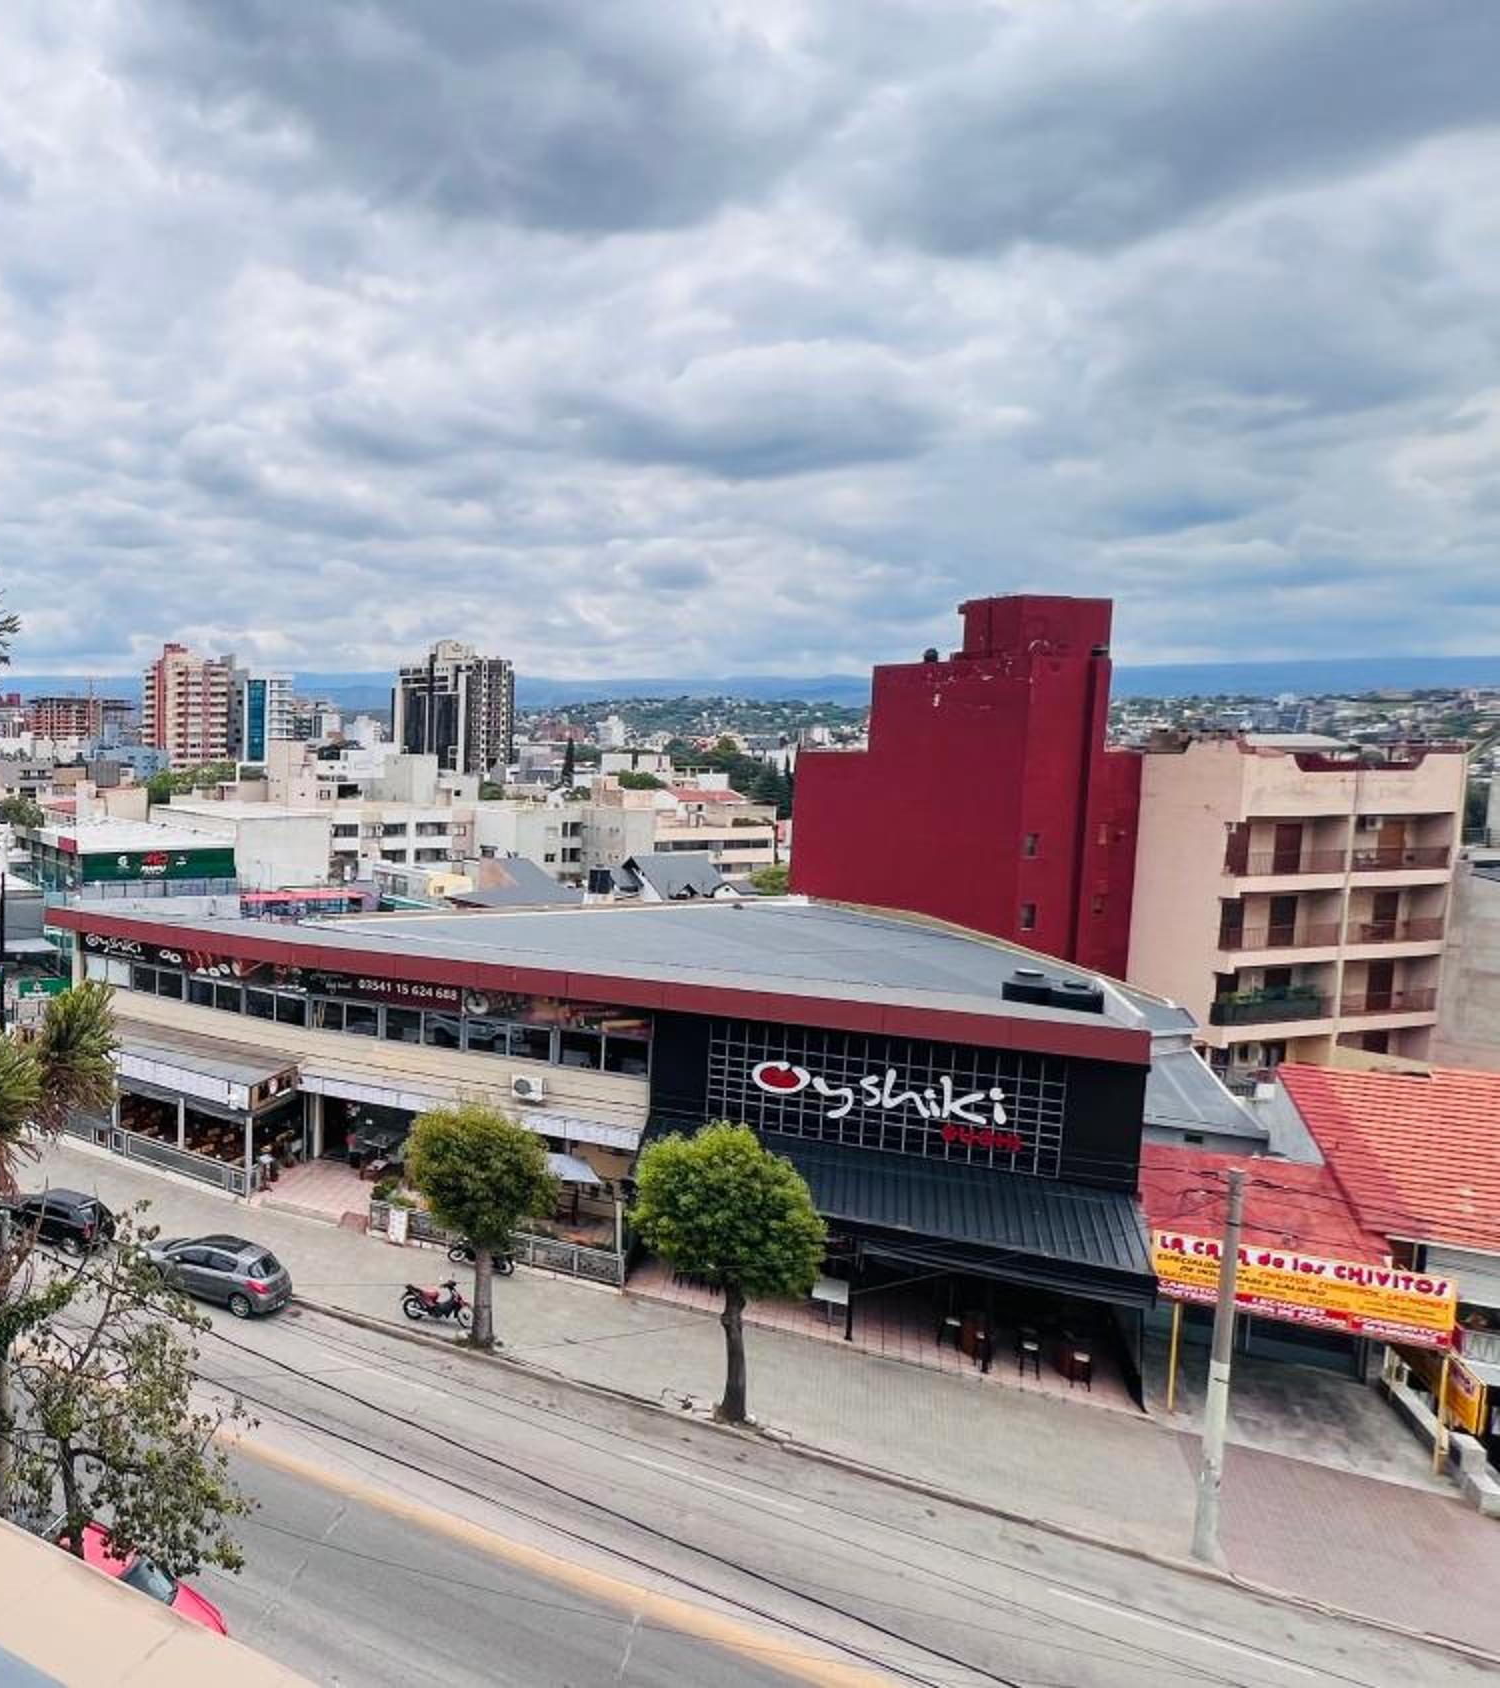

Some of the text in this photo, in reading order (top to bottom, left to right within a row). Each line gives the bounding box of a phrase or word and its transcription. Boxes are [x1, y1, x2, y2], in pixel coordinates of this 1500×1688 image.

[358, 979, 391, 992] 03541
[397, 984, 409, 995] 15
[411, 986, 433, 998] 624
[752, 1061, 1007, 1124] Oyshiki
[1160, 1235, 1186, 1256] LA
[1193, 1241, 1251, 1266] CAA
[1258, 1252, 1285, 1269] de
[1292, 1257, 1326, 1275] los
[1334, 1265, 1448, 1296] CHIVITOS
